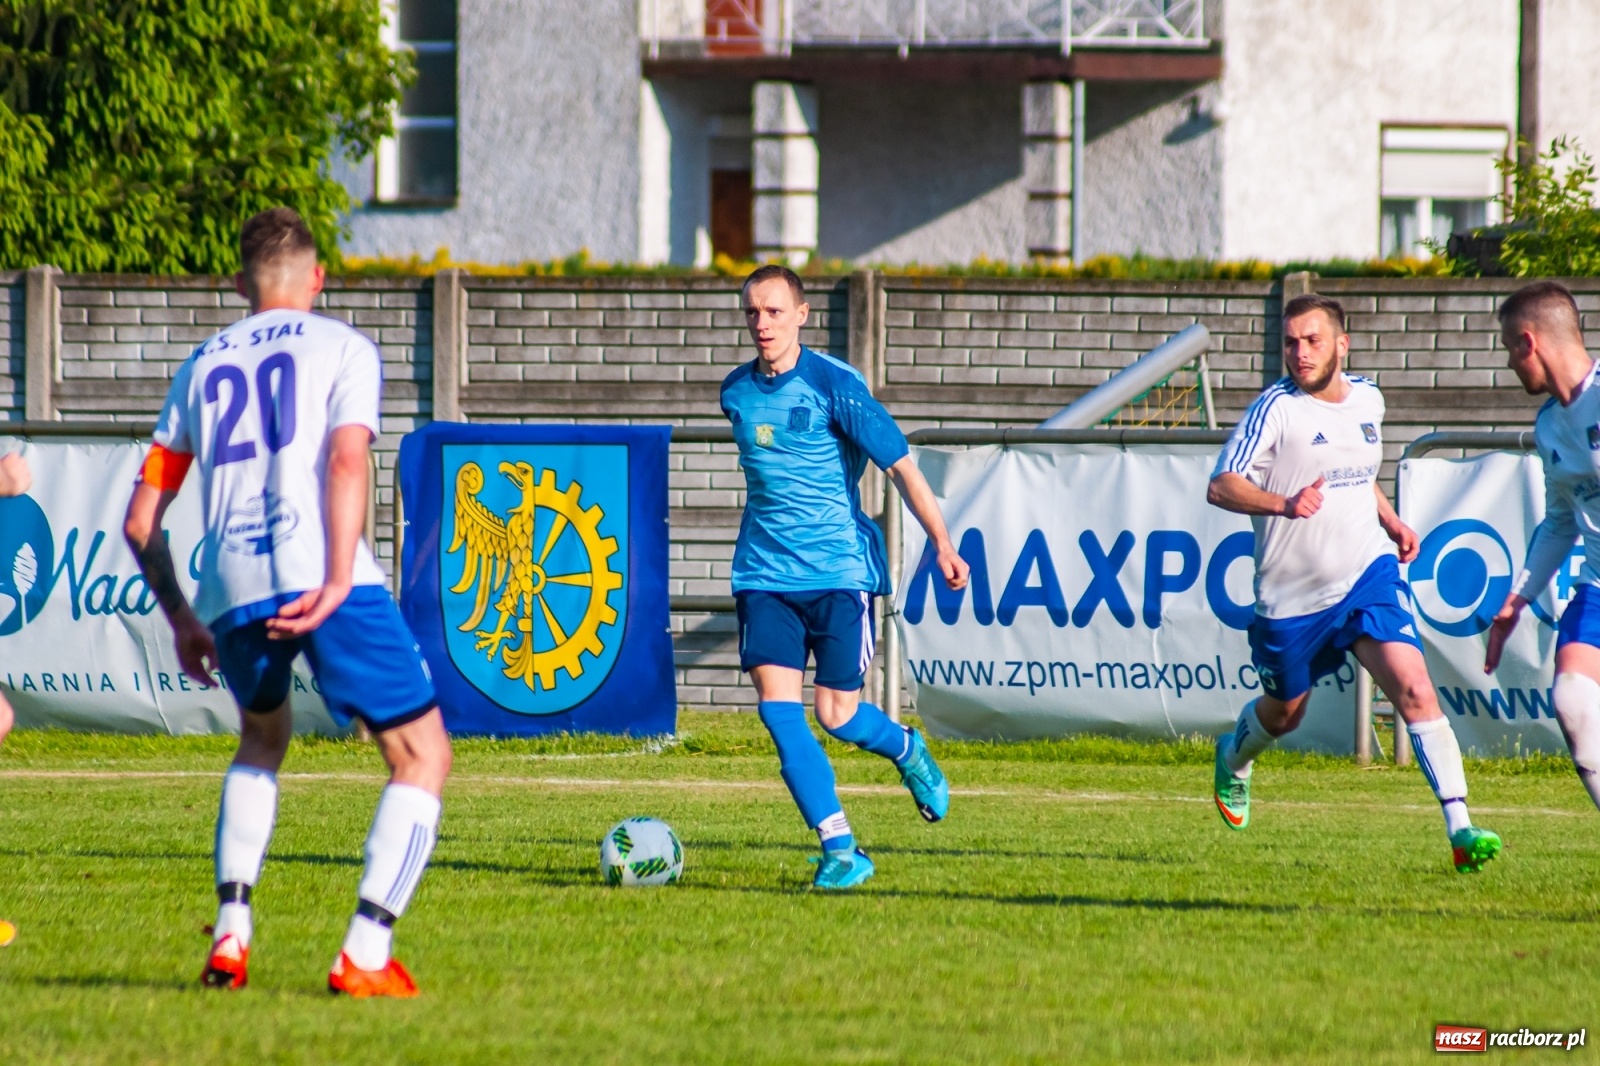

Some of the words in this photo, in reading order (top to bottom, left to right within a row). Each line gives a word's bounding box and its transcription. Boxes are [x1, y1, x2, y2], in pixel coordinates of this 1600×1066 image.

[250, 321, 305, 346] STAL
[203, 350, 298, 468] 20
[903, 527, 1257, 631] MAXPO
[133, 671, 142, 692] I
